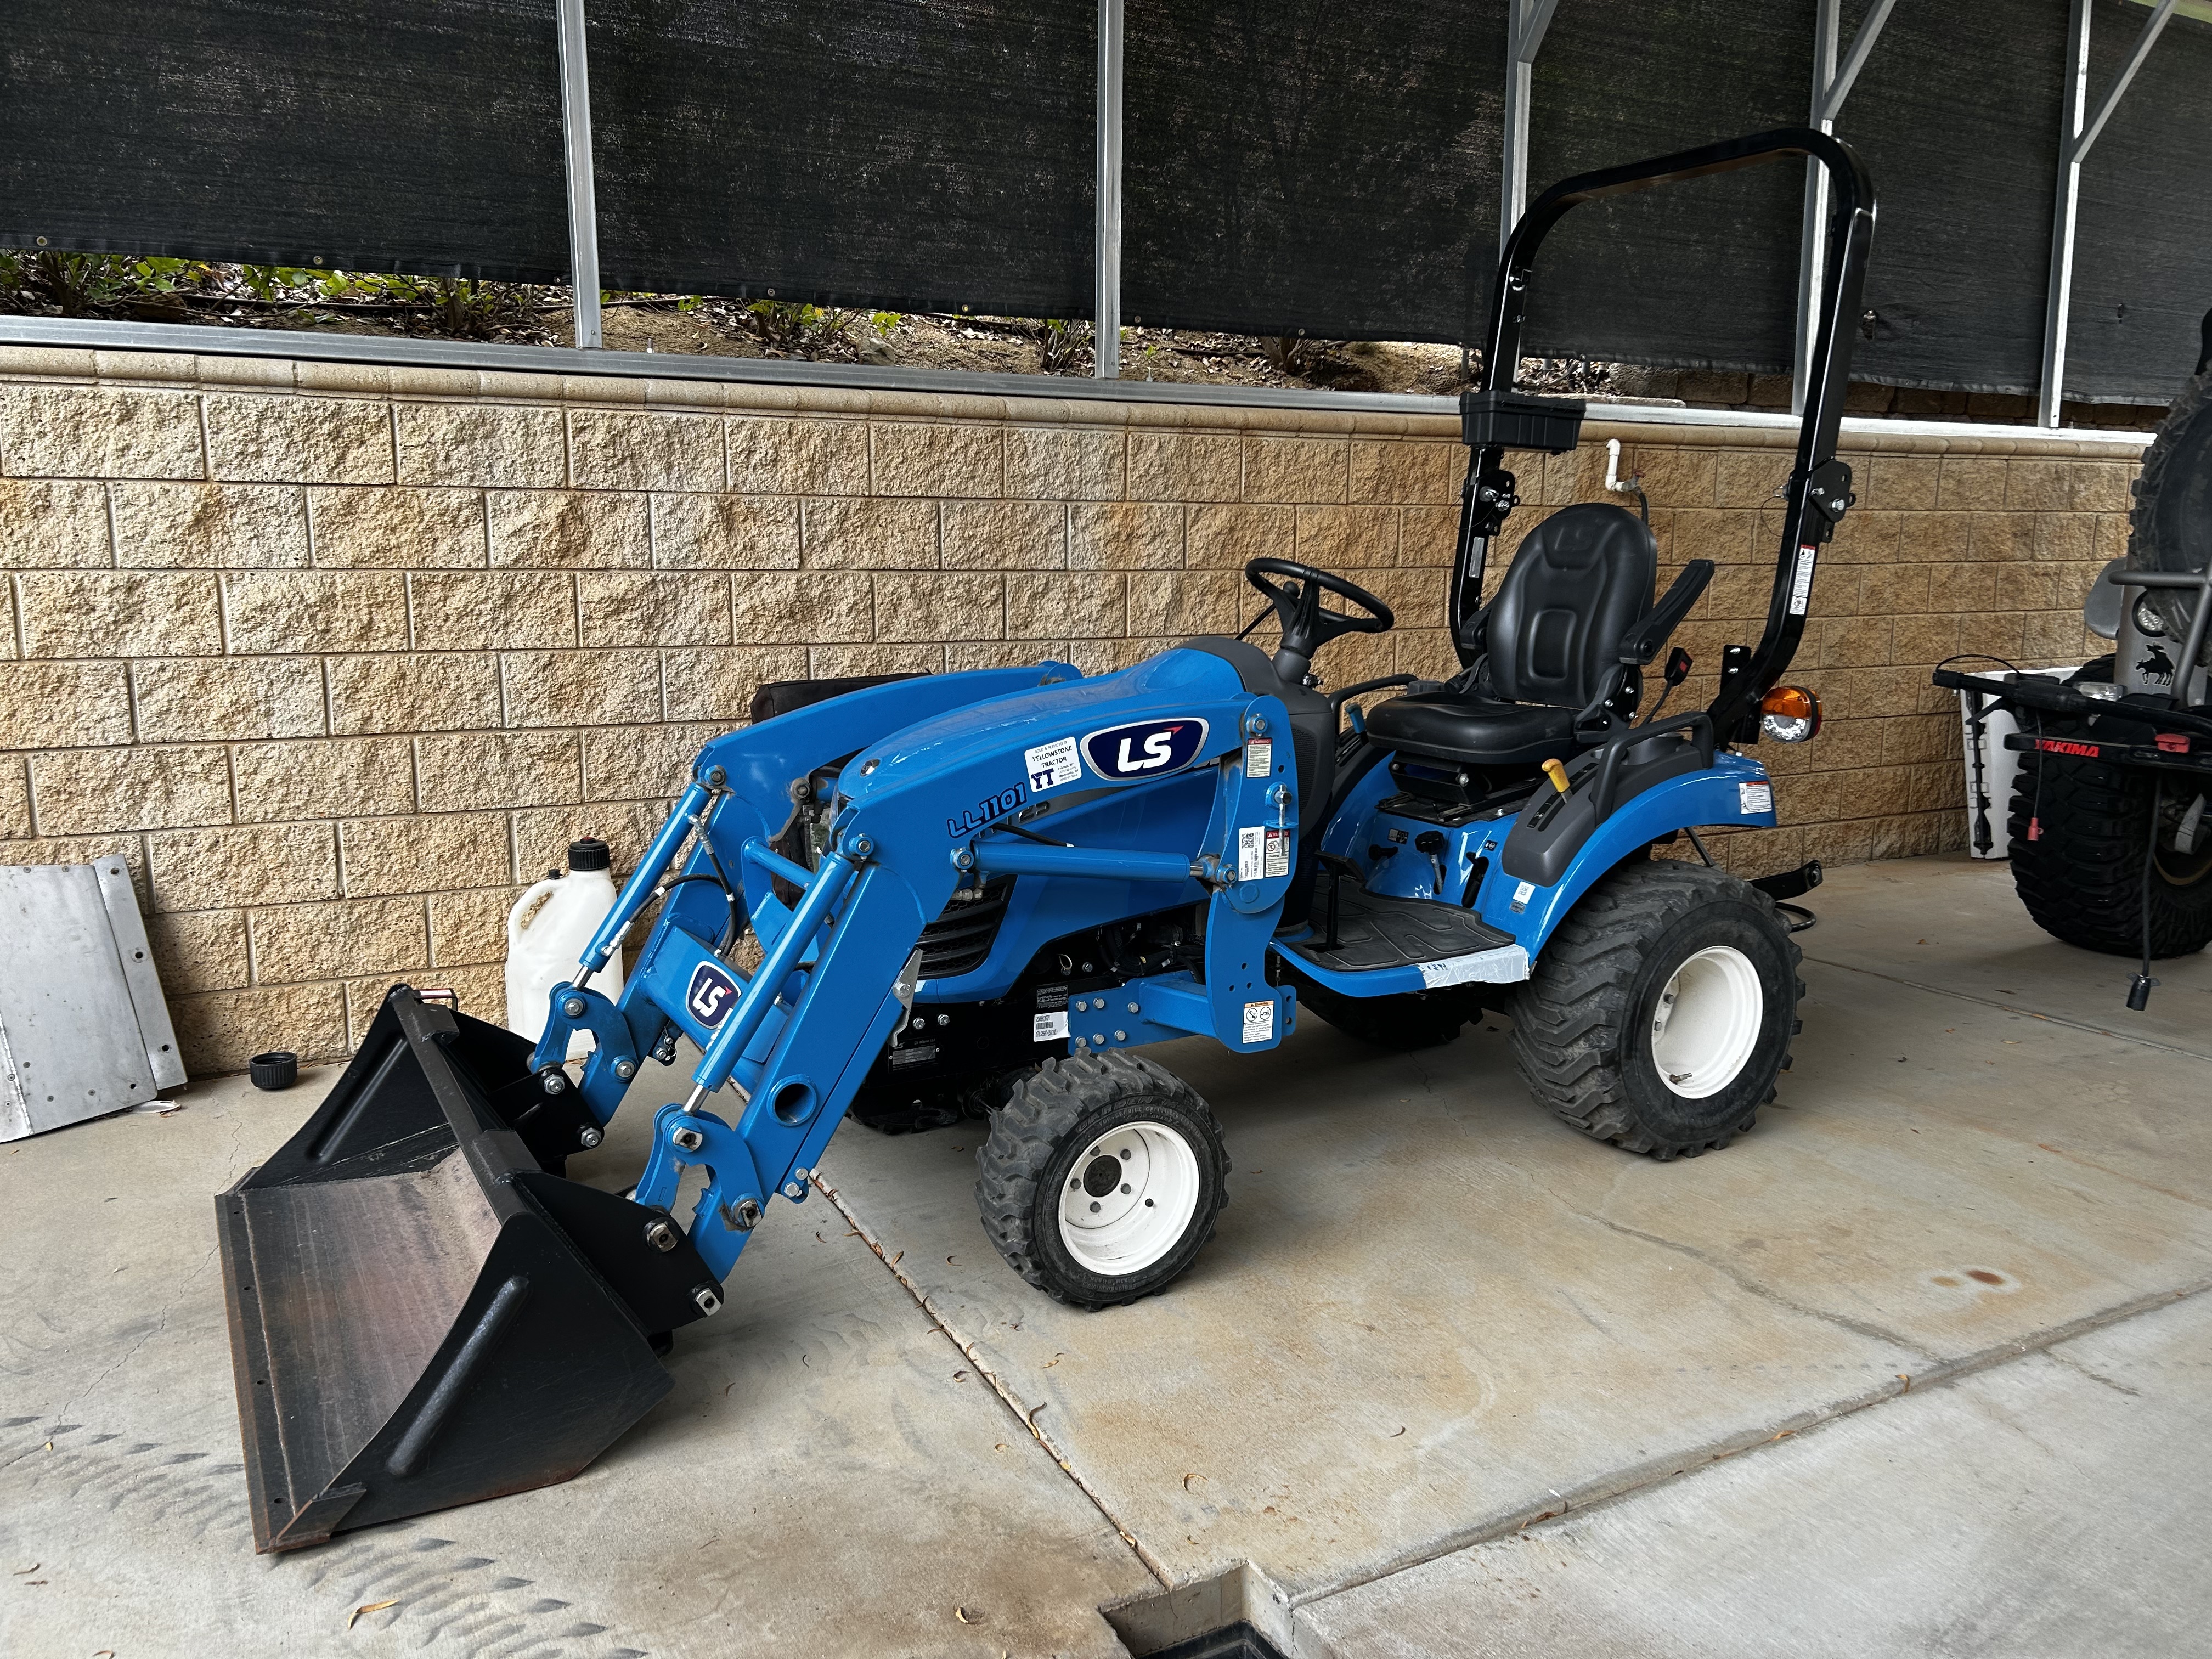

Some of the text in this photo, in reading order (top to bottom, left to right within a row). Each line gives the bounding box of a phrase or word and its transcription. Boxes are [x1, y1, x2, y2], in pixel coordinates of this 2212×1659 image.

[1032, 745, 1073, 762] YELLOWSTONE
[1117, 731, 1172, 772] LS
[2035, 738, 2100, 758] YAKIMA
[1041, 756, 1067, 769] TRACTOR
[1031, 768, 1054, 790] YT
[947, 782, 1028, 839] LL1101
[692, 977, 726, 1017] LS
